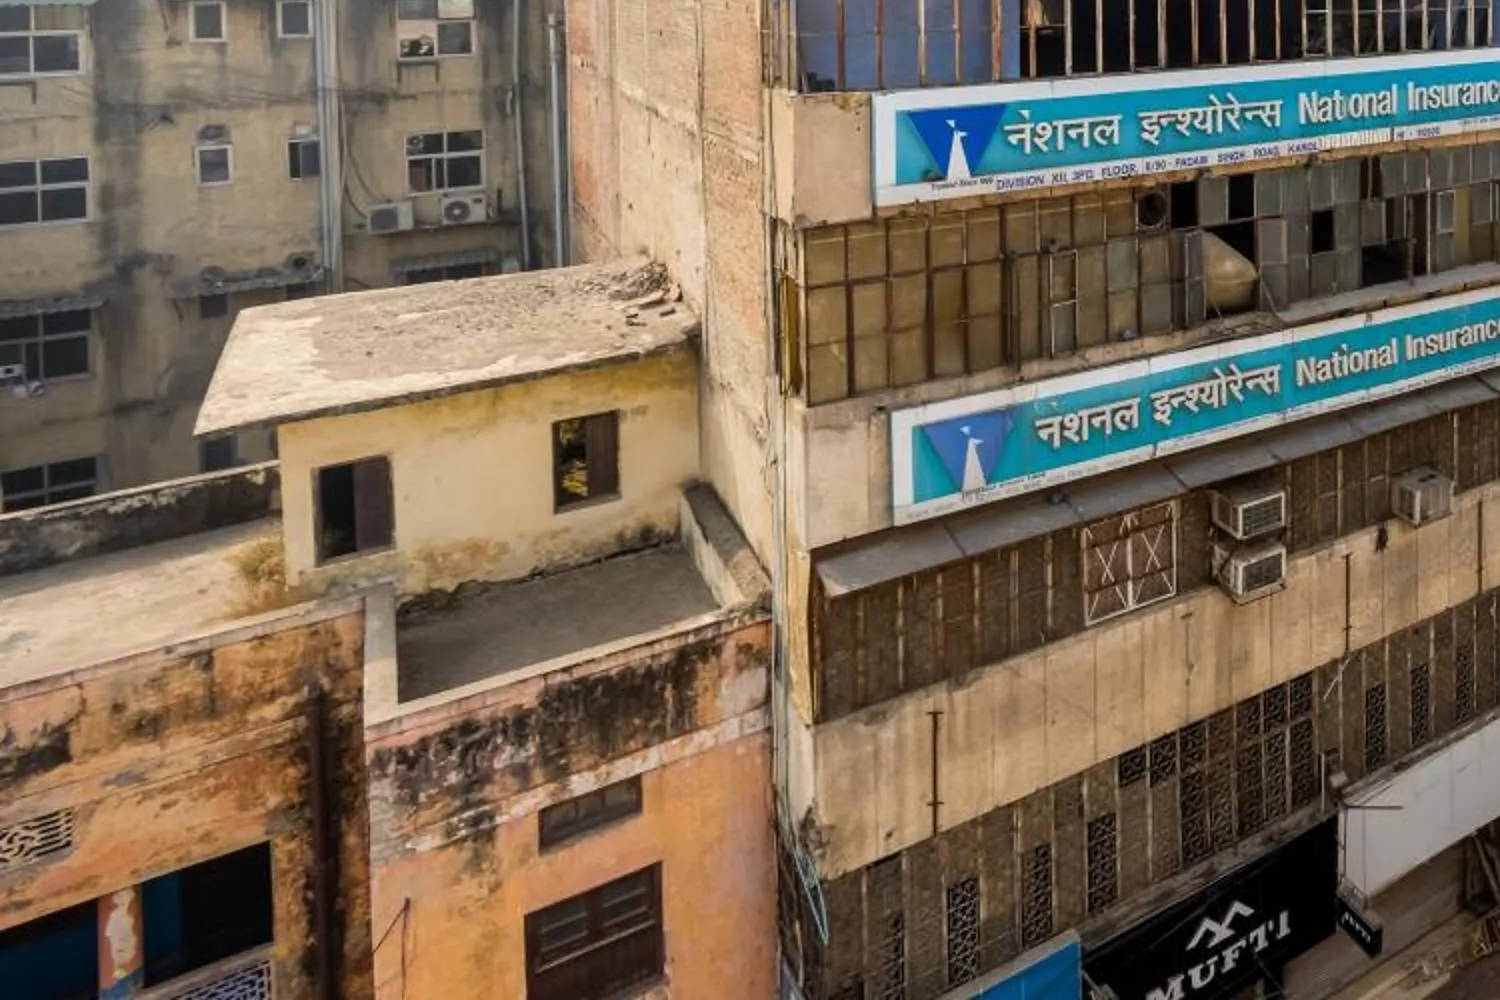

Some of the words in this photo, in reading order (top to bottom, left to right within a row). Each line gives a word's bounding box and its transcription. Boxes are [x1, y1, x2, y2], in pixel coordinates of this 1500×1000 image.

[1298, 83, 1398, 125] Natonal
[995, 176, 1045, 191] DIVISION
[1295, 338, 1398, 388] National
[1146, 909, 1291, 1000] MUFTI
